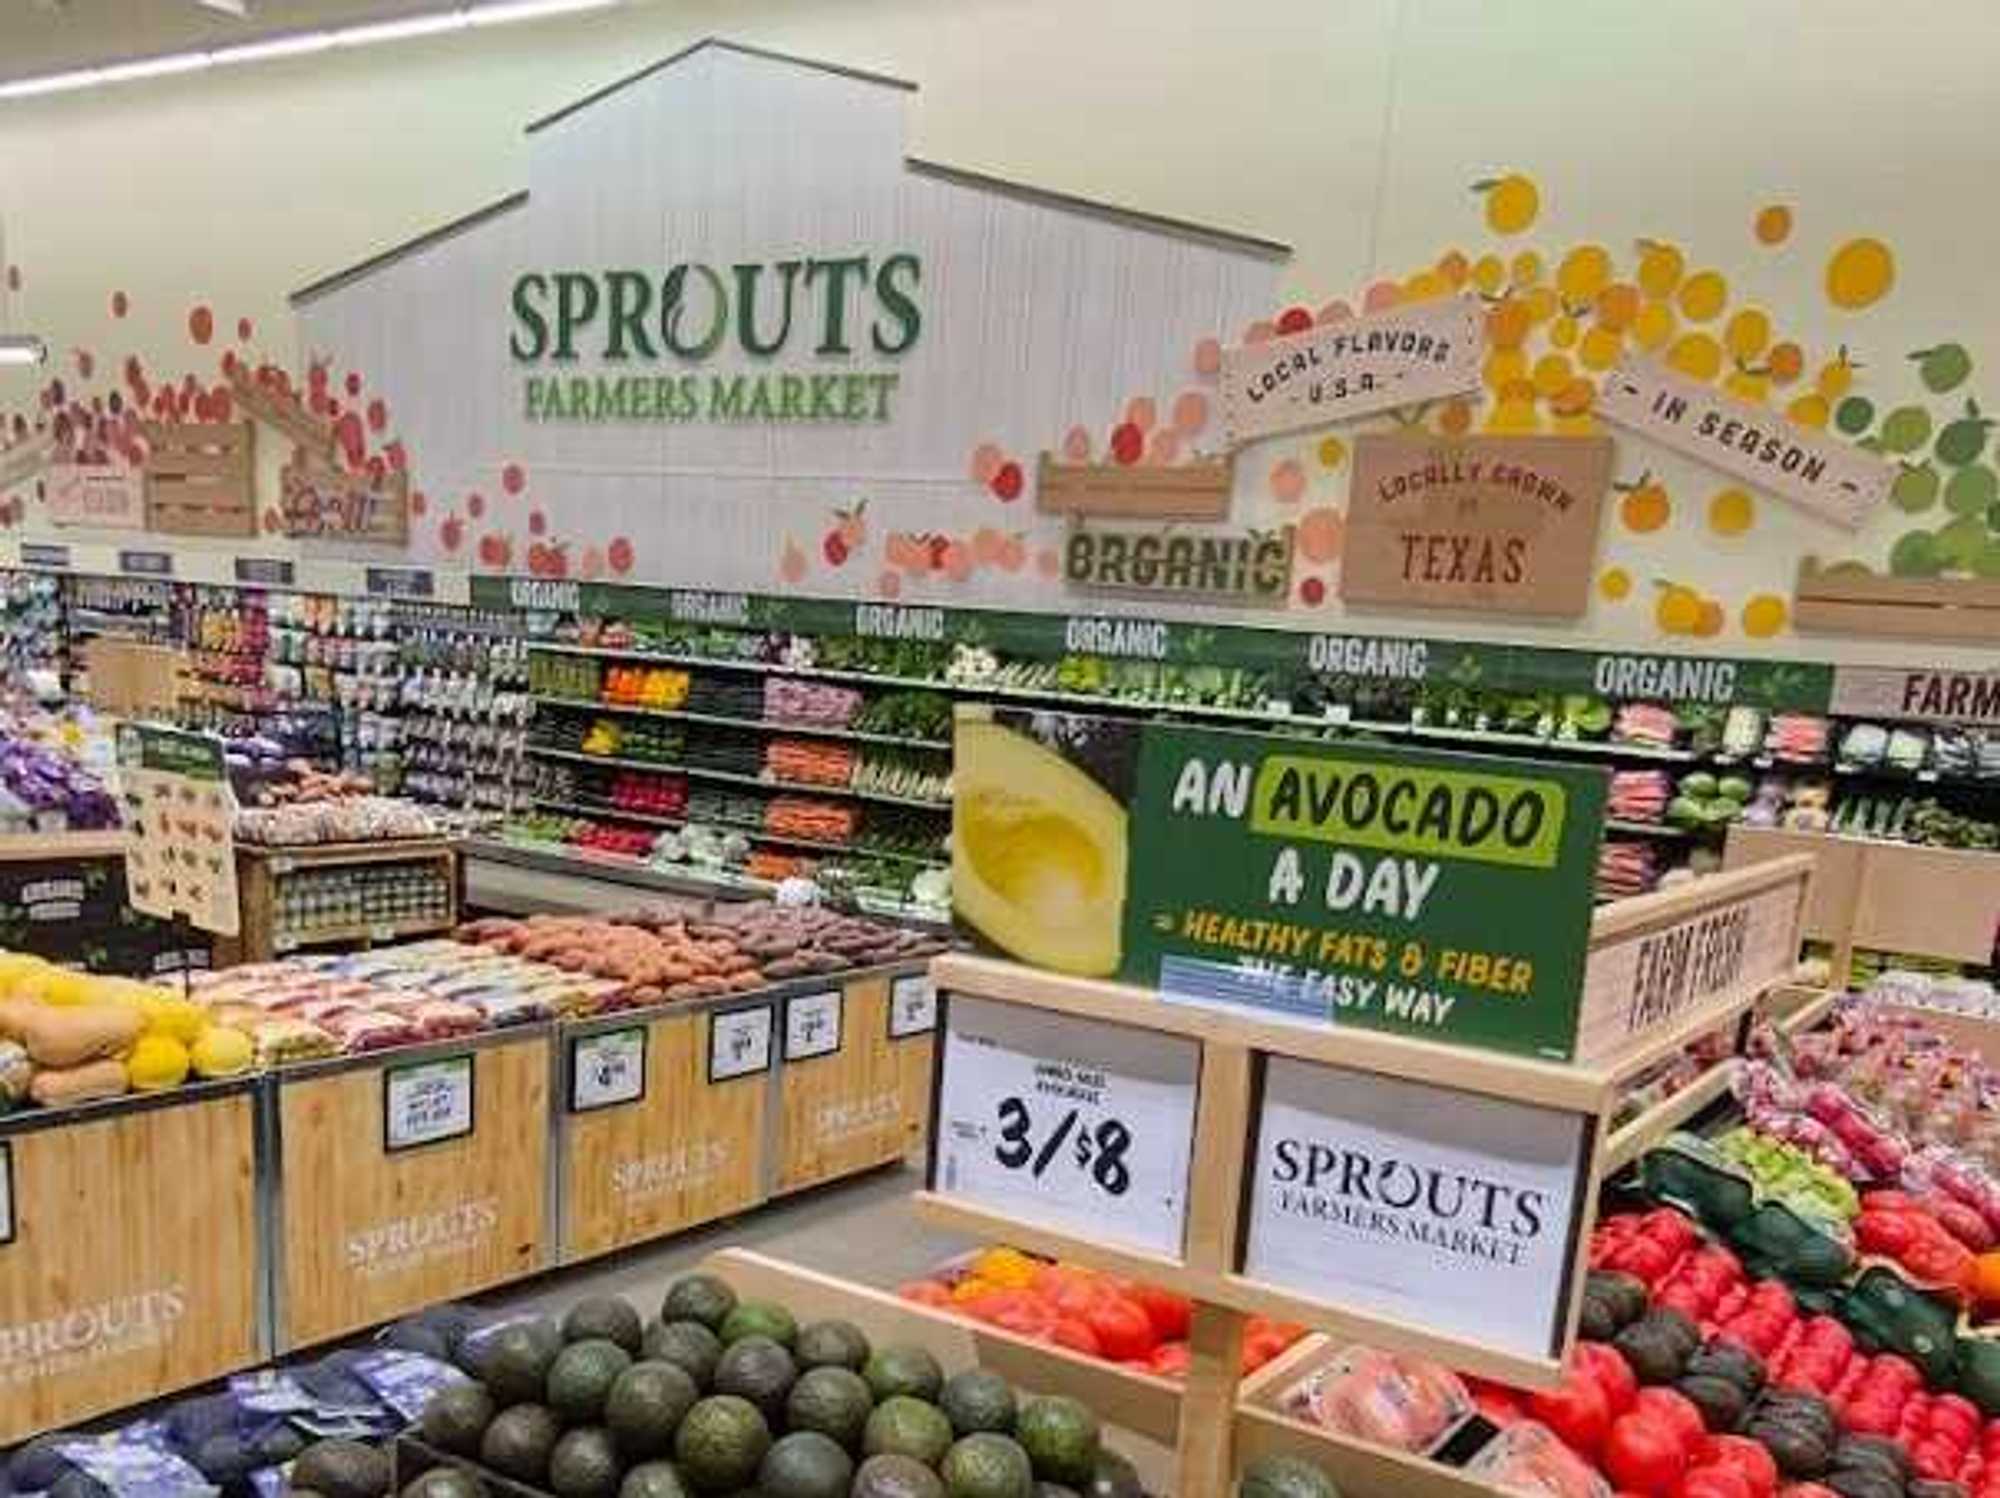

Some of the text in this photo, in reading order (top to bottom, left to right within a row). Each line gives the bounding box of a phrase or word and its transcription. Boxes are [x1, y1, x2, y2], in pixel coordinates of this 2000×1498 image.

[510, 253, 923, 363] SPROUTS
[525, 372, 900, 424] FARMERS MARKET
[1247, 330, 1451, 403] LOCAL FLAVORS
[1652, 391, 1828, 483] IN SEASON
[1378, 461, 1482, 503] LOCALLY
[1066, 528, 1284, 592] ORGANIC
[1399, 532, 1527, 584] TEXAS
[855, 603, 945, 638] ORGANIC
[1065, 618, 1168, 659] ORGANIC
[1309, 635, 1429, 679] ORGANIC
[1595, 655, 1737, 701] ORGANIC
[1173, 759, 1546, 849] AN AVOCADO
[1268, 847, 1440, 921] A DAY
[1184, 910, 1313, 956] HEALTHY
[1319, 930, 1388, 973] FATS
[1438, 950, 1535, 995] FIBER
[1386, 983, 1457, 1027] WAY
[994, 1095, 1132, 1197] 3/$8
[1272, 1139, 1543, 1239] SPROUTS
[1278, 1188, 1528, 1265] FARMERS MARKET
